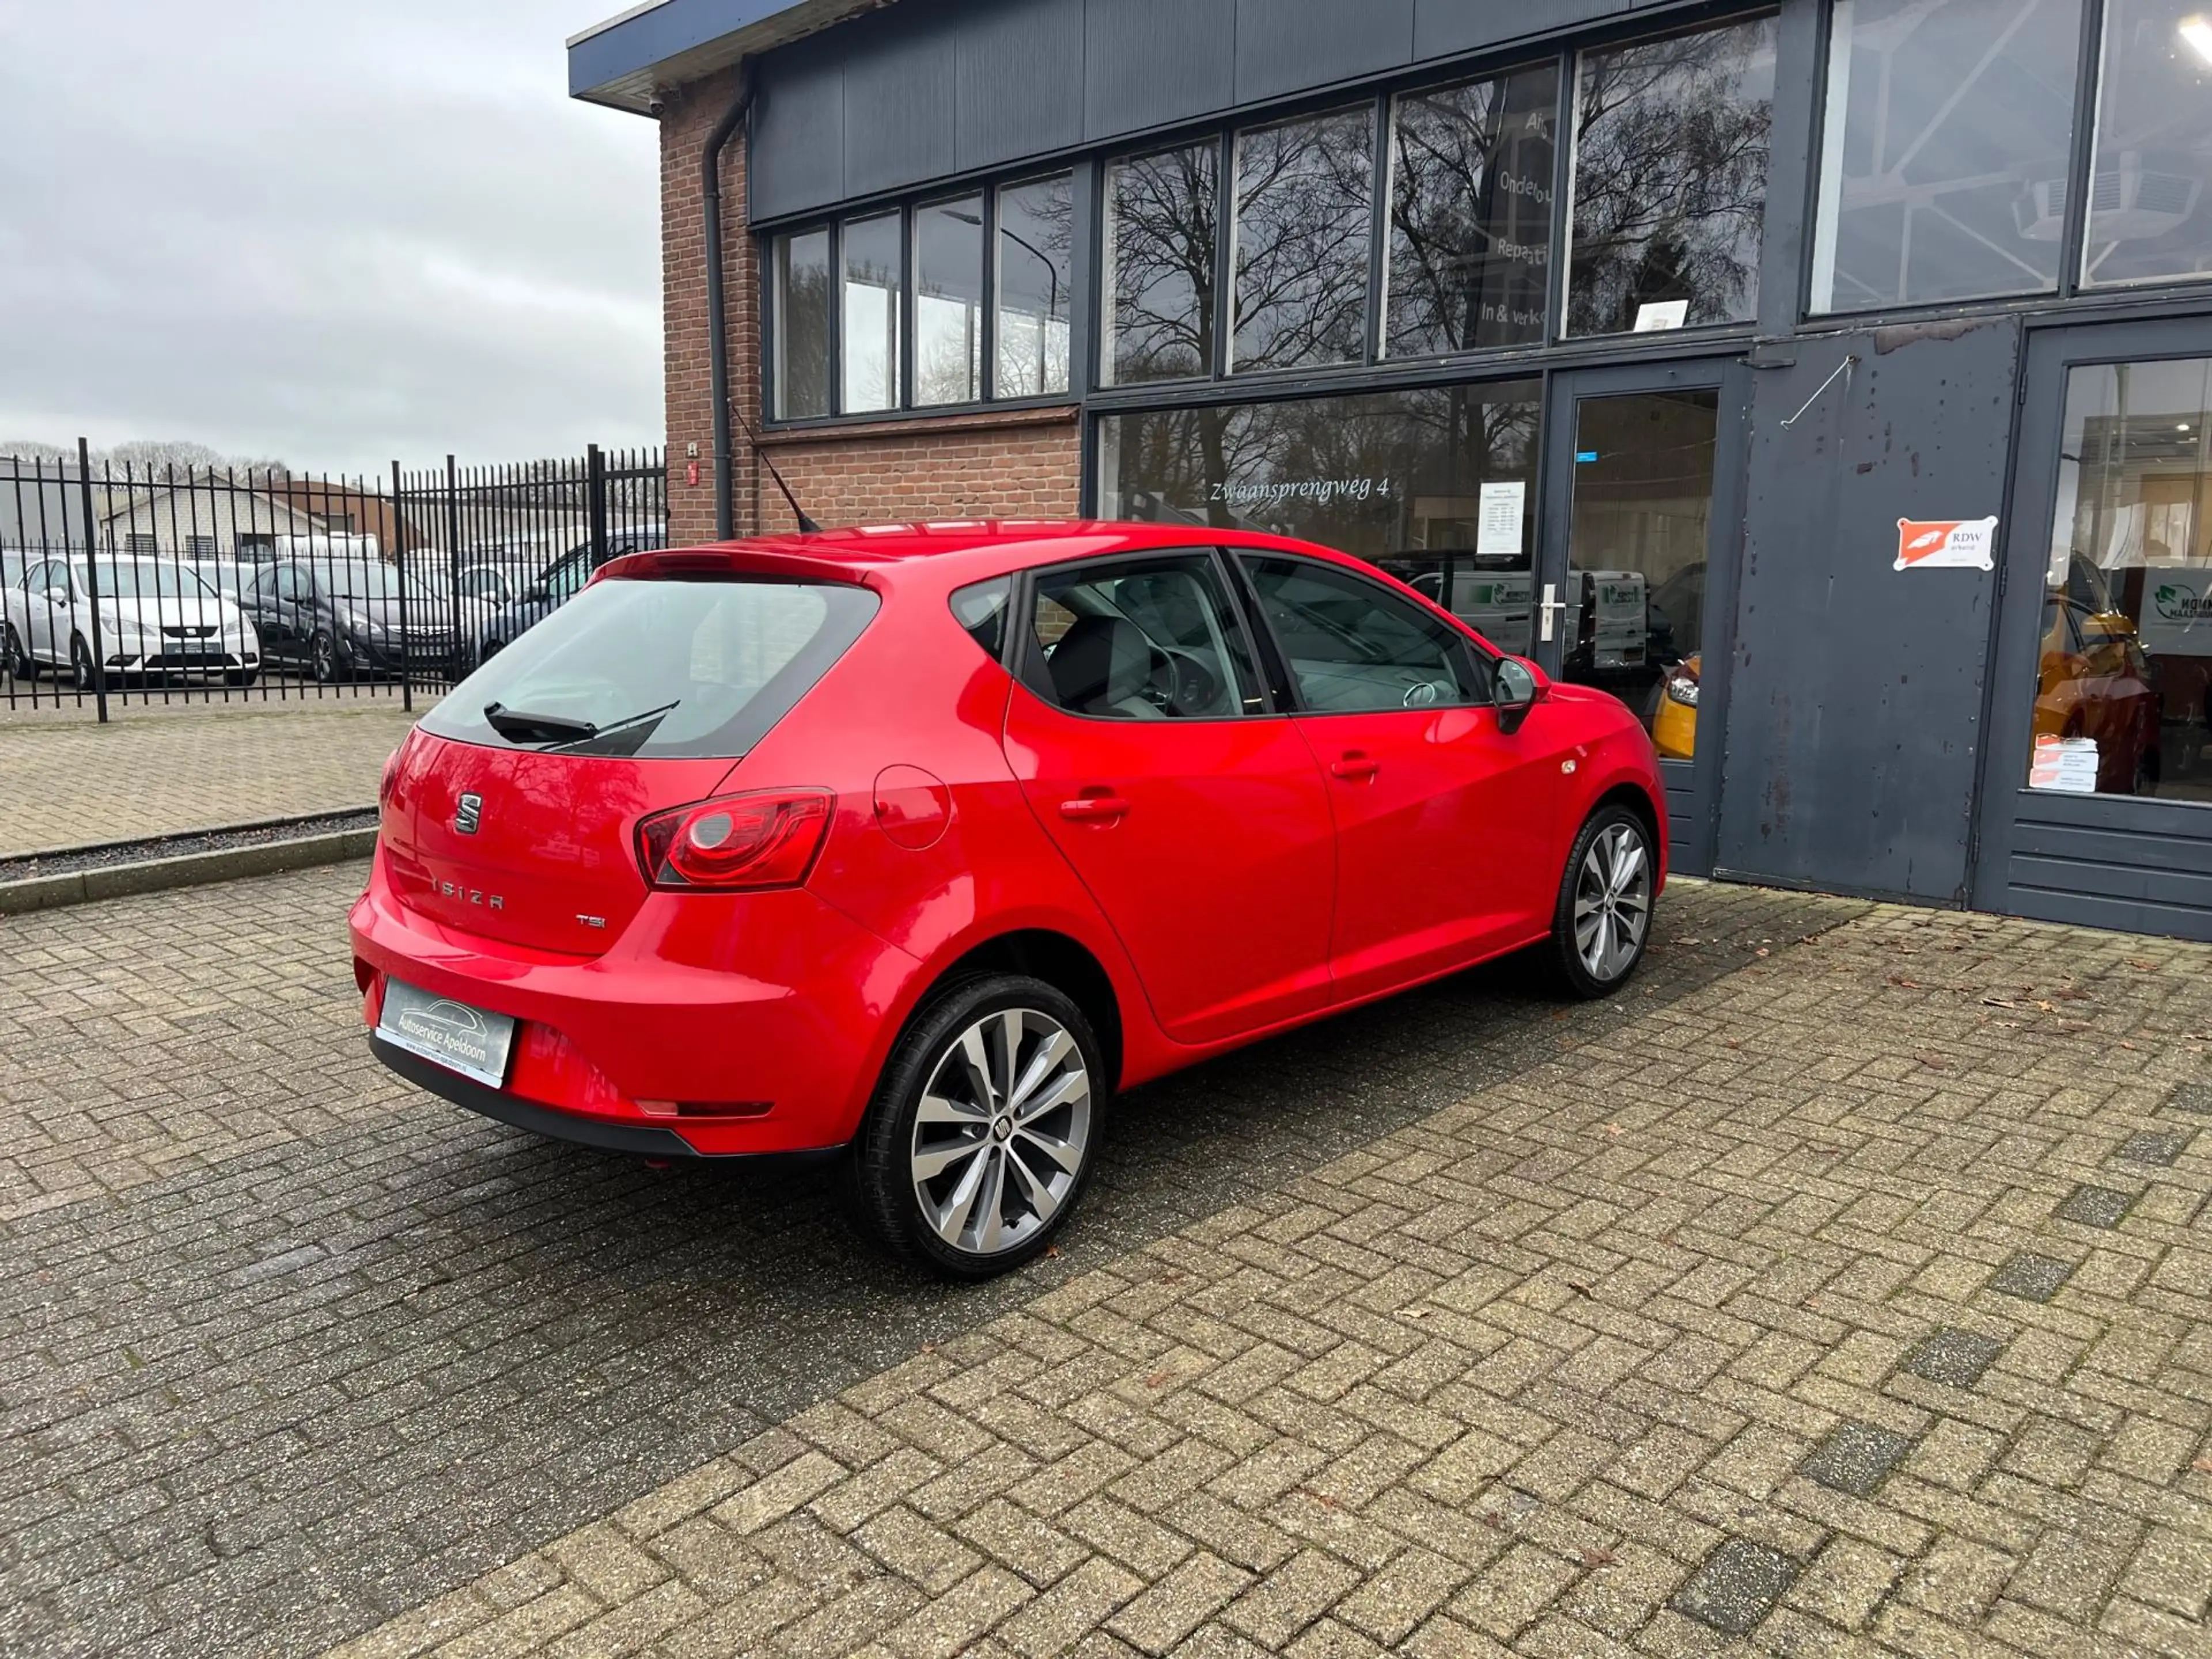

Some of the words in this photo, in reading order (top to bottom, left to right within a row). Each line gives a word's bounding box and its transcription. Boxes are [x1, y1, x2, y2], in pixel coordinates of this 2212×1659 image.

[1482, 302, 1494, 320] In
[1496, 304, 1509, 323] &
[1210, 478, 1372, 505] Zwaansprengweg
[1376, 478, 1389, 496] 4
[1953, 532, 1983, 543] RDW
[433, 877, 504, 910] IBIZA
[576, 914, 606, 928] TSI
[398, 1016, 443, 1044] Autoservice
[444, 1033, 487, 1062] Apeldoorn
